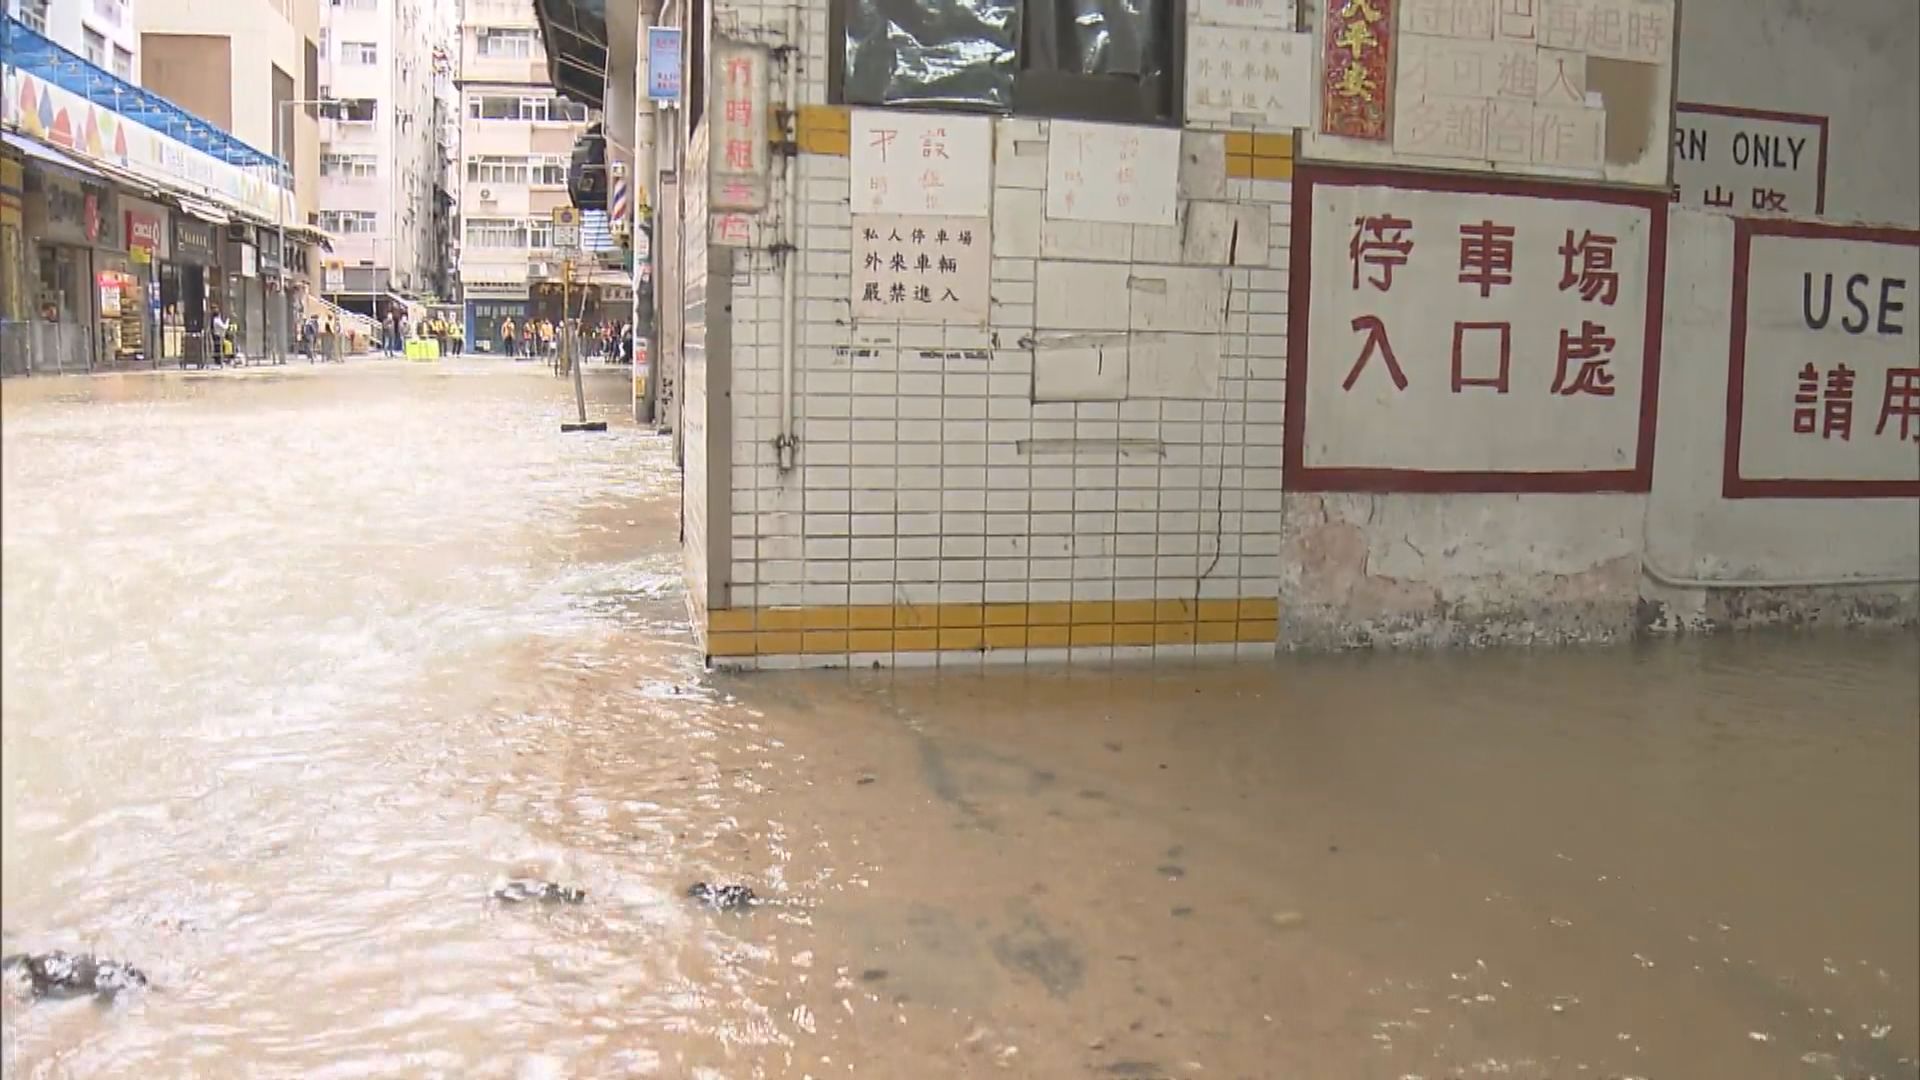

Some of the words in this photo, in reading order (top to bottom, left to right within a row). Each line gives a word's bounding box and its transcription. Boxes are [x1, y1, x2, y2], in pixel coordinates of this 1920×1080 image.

[1732, 132, 1806, 170] ONLY
[864, 251, 957, 273] 外來車輛
[862, 282, 960, 304] 嚴禁進入
[1803, 272, 1906, 335] USE
